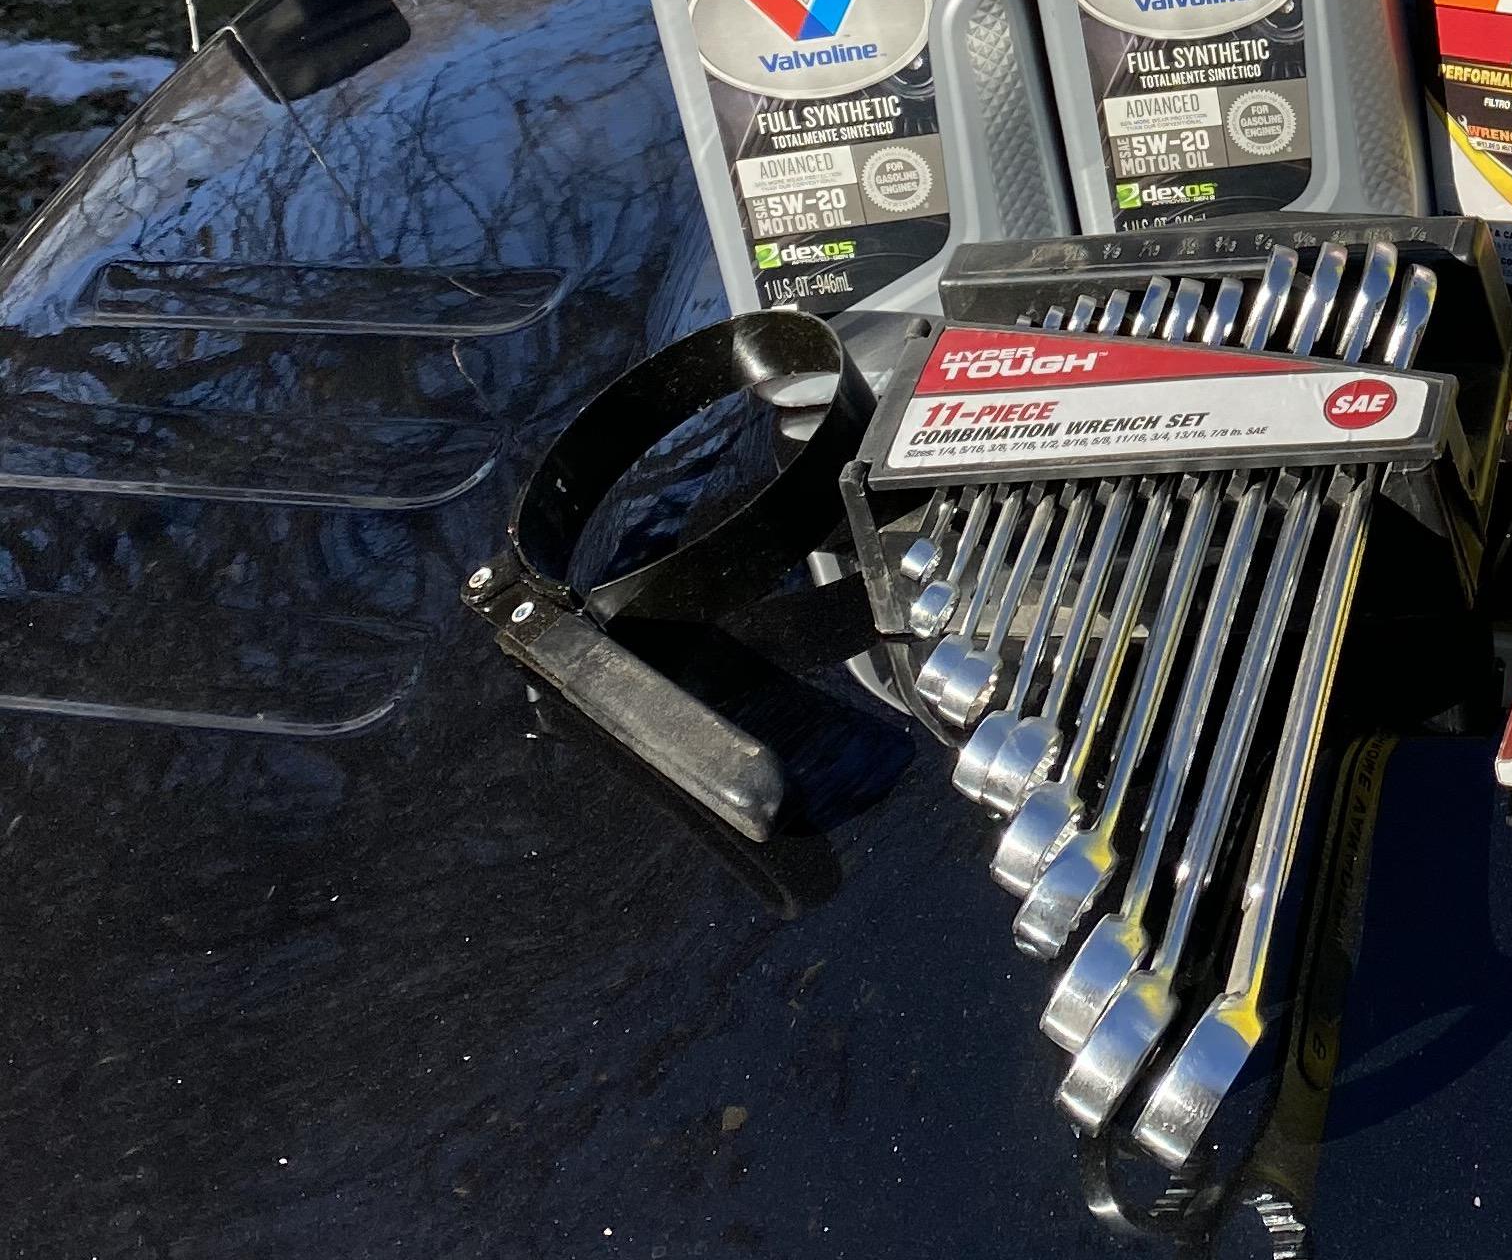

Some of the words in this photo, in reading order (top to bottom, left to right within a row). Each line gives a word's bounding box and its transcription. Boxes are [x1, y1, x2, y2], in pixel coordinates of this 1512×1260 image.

[759, 43, 877, 72] Valvoline
[1127, 50, 1170, 74] FULL
[1173, 38, 1270, 69] SYNTHETIC
[1140, 71, 1206, 89] TOTALMENTE
[1208, 64, 1261, 82] SINTÉTICO
[757, 110, 801, 135] FULL
[803, 95, 901, 128] SYNTHETIC
[1126, 94, 1200, 118] ADVANCED
[1483, 98, 1511, 111] FILTRO
[772, 128, 839, 150] TOTALMENTE
[840, 121, 894, 140] SINTÉTICO
[1117, 138, 1131, 159] SAE
[1132, 130, 1210, 157] 5W-20
[760, 153, 833, 179] ADVANCED
[1120, 154, 1181, 175] MOTOR
[1186, 151, 1214, 168] OIL
[753, 198, 767, 219] SAE
[767, 188, 846, 216] 5W-20
[1142, 183, 1215, 202] dexos
[758, 212, 819, 236] MOTOR
[823, 209, 851, 227] OIL
[781, 241, 854, 261] dexos
[764, 281, 772, 300] 1
[940, 352, 1099, 381] TOUGH
[943, 347, 1036, 364] HYPER
[922, 401, 1060, 428] 11-PIECE
[1332, 394, 1389, 414] SAE
[910, 422, 1060, 446] COMBINATION
[1066, 415, 1163, 436] WRENCH
[1165, 412, 1210, 429] SET
[1246, 426, 1268, 435] SAE
